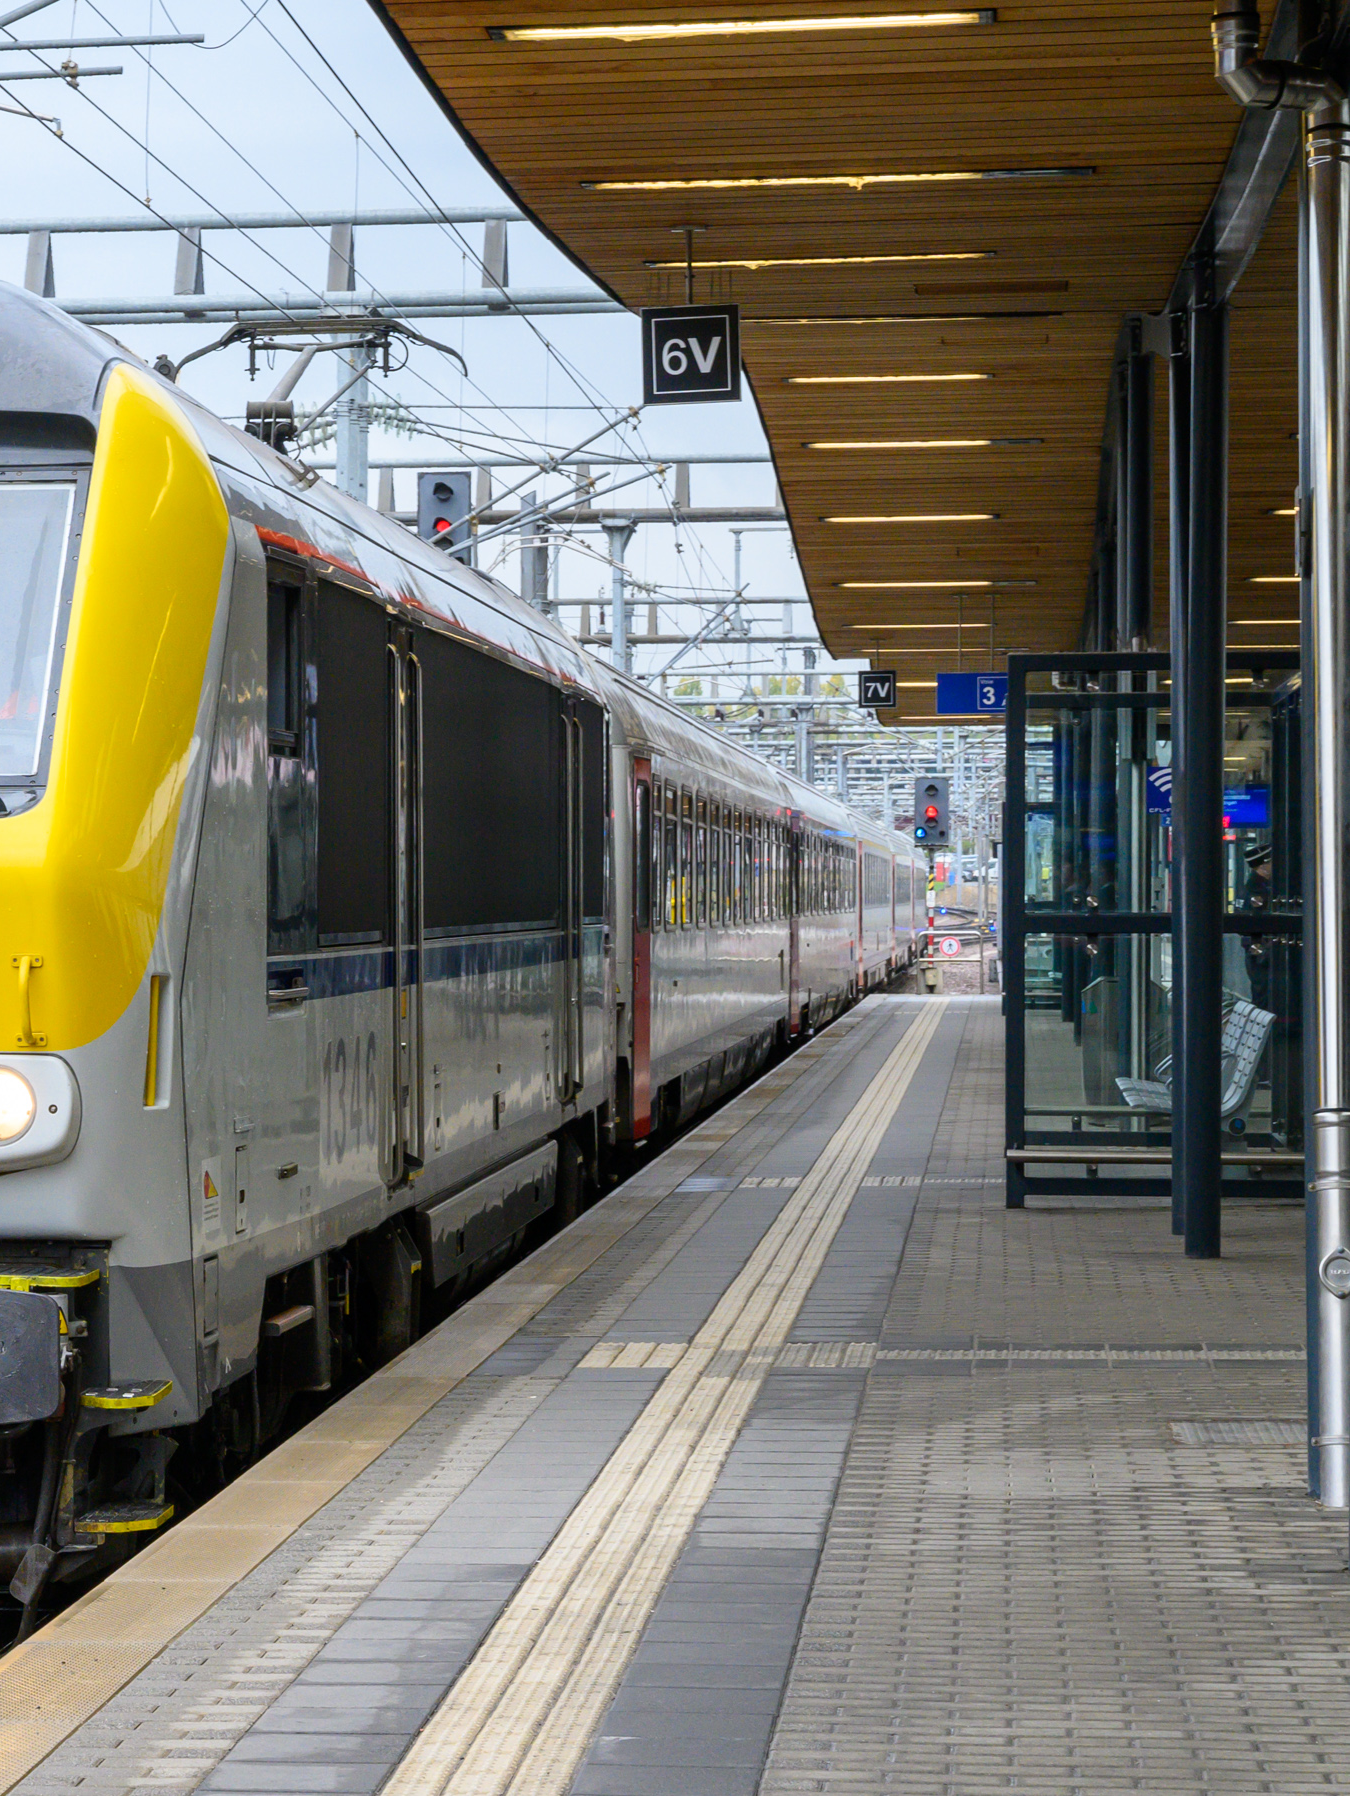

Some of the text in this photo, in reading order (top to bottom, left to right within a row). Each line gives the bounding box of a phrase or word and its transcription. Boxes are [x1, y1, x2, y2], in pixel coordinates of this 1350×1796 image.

[662, 336, 722, 375] 6V
[865, 682, 890, 698] 7V
[982, 686, 996, 705] 3
[323, 1031, 377, 1166] 1346
